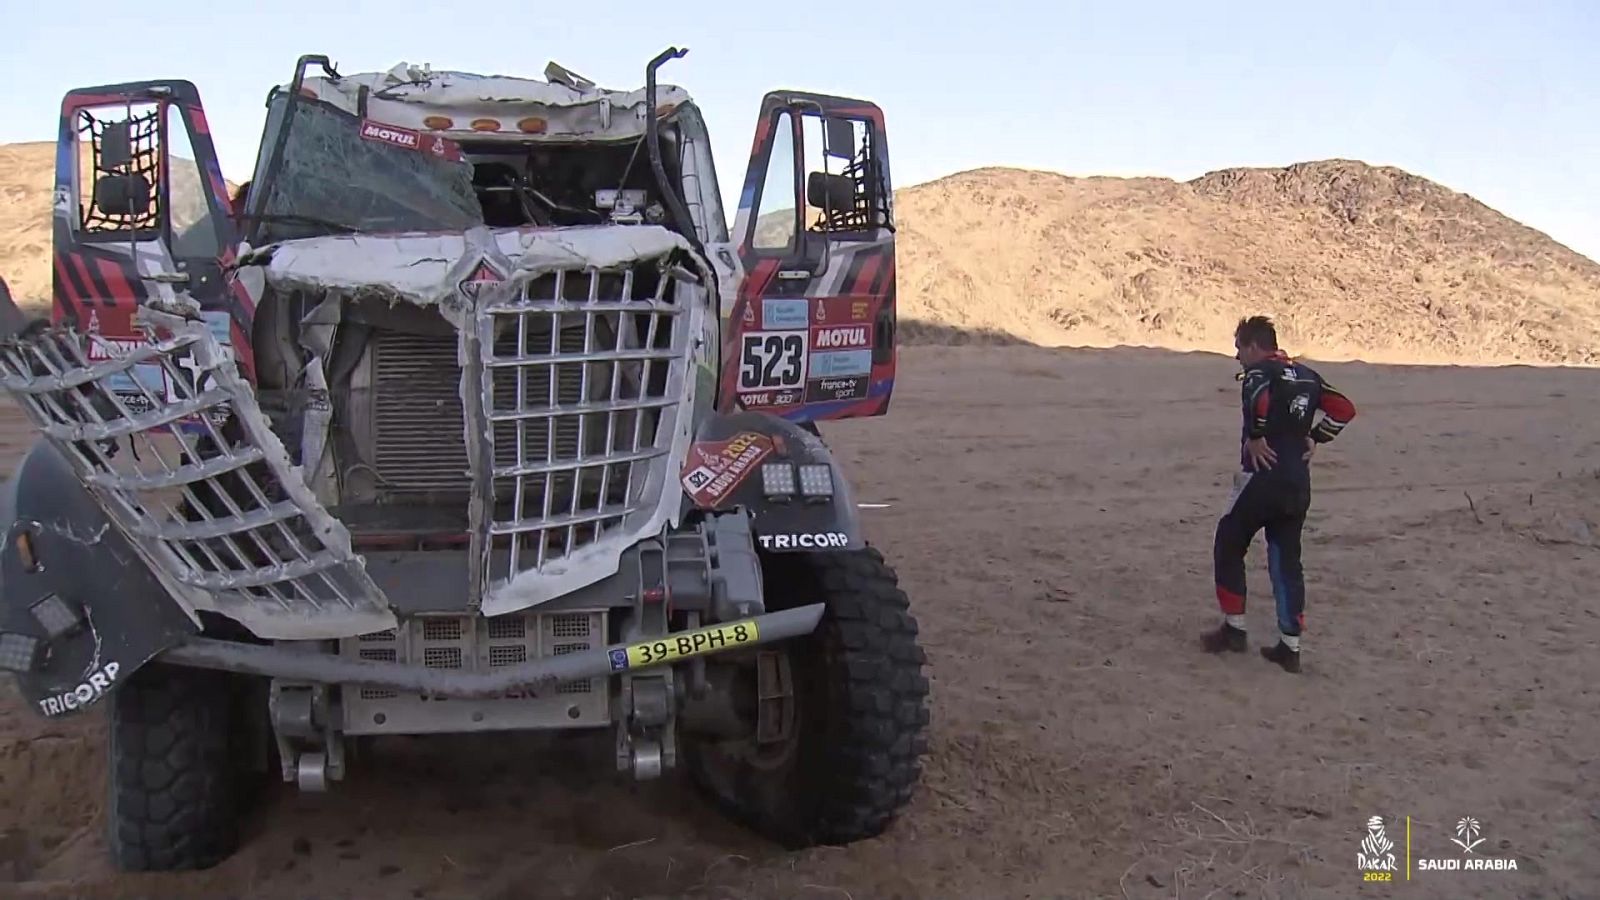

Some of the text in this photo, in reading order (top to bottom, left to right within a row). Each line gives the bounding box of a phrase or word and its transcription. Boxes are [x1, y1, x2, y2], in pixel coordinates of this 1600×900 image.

[364, 126, 416, 145] MOTUL
[816, 328, 866, 347] MOTUL
[742, 335, 803, 388] 523
[723, 434, 758, 458] 2022
[759, 532, 848, 549] TRICORP
[638, 624, 748, 663] 39-BPH-8
[39, 661, 120, 716] TRICORP
